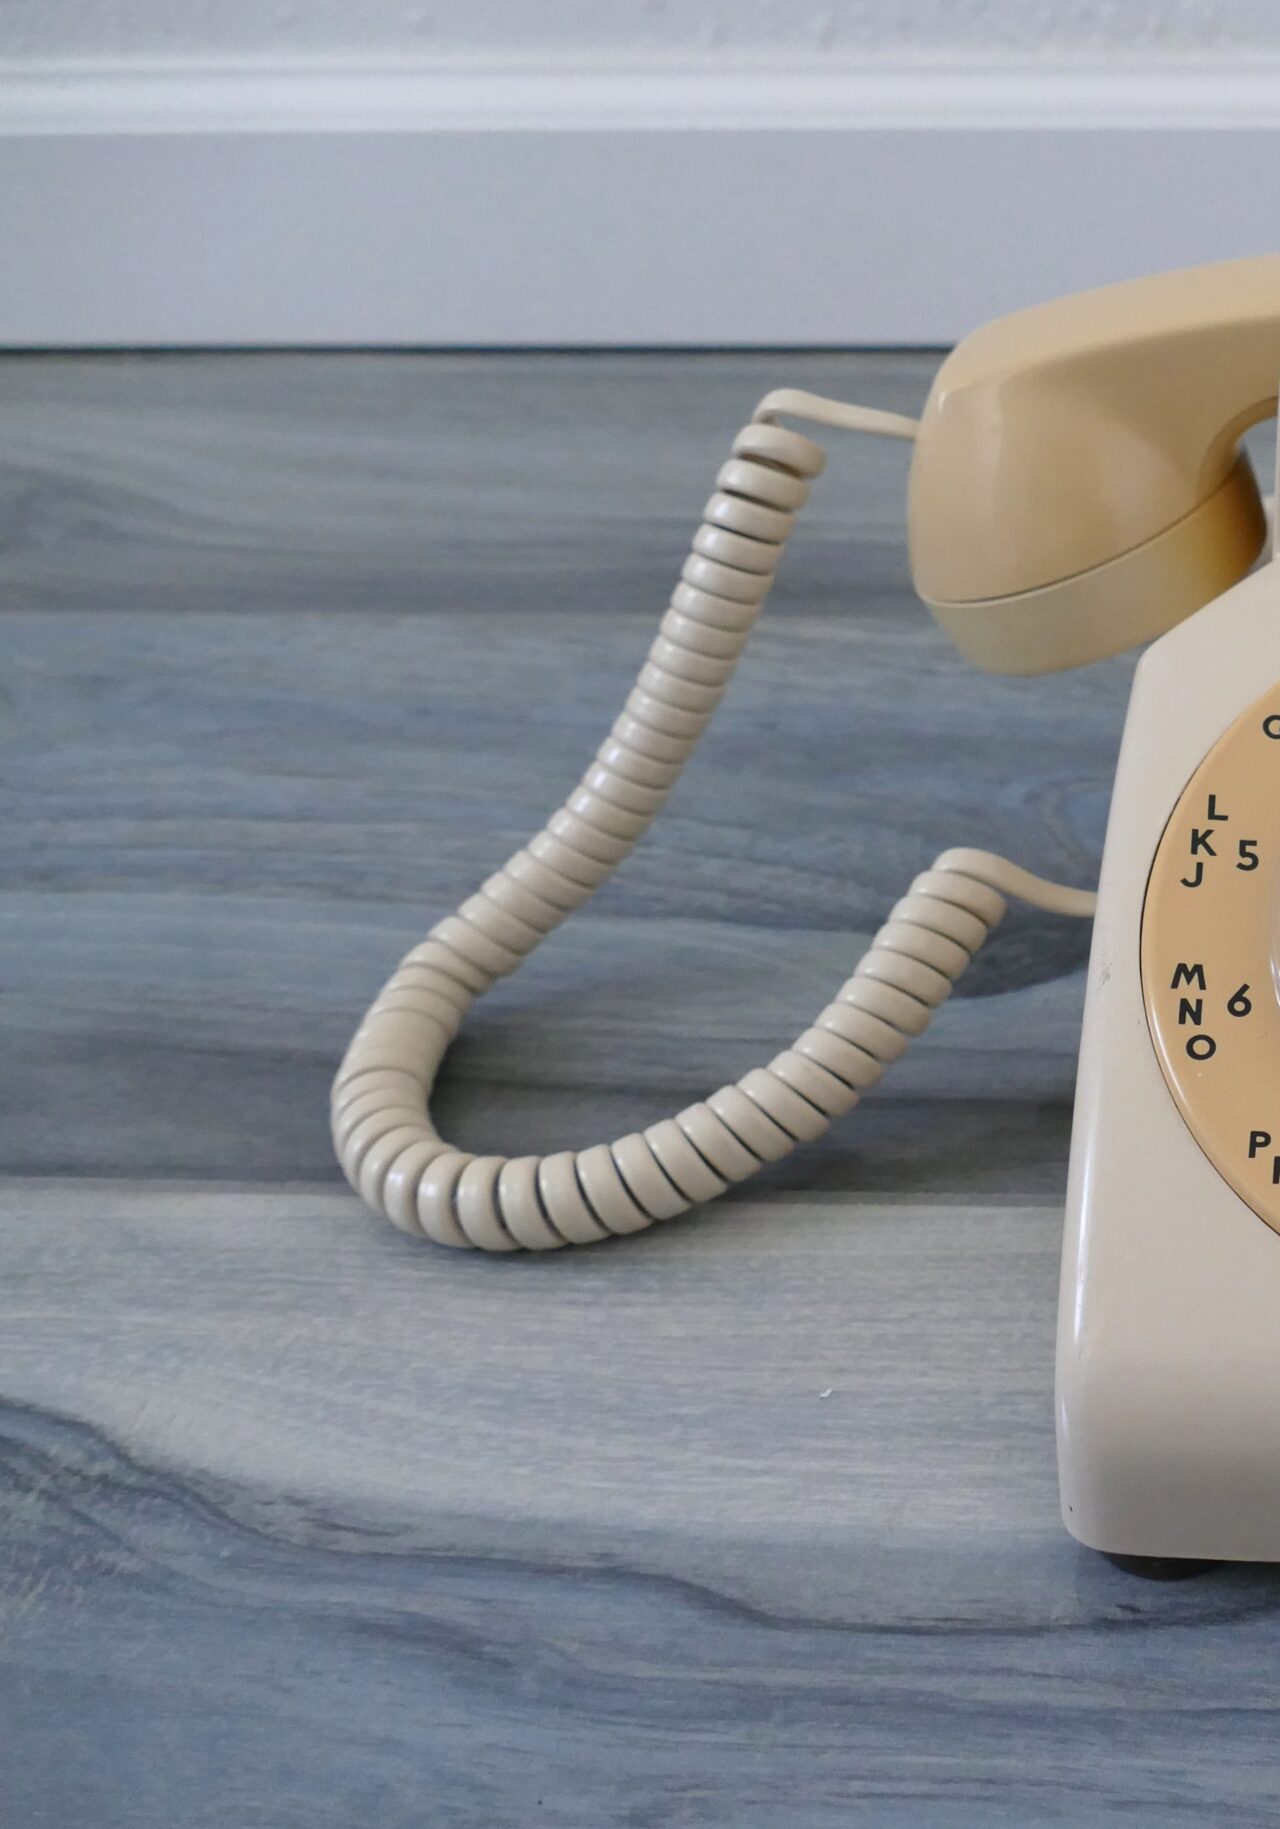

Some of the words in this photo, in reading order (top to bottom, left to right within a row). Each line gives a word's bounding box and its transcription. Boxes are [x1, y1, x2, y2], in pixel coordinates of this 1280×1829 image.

[1235, 839, 1260, 872] 5
[1170, 962, 1217, 1062] MNO
[1226, 983, 1252, 1018] 6
